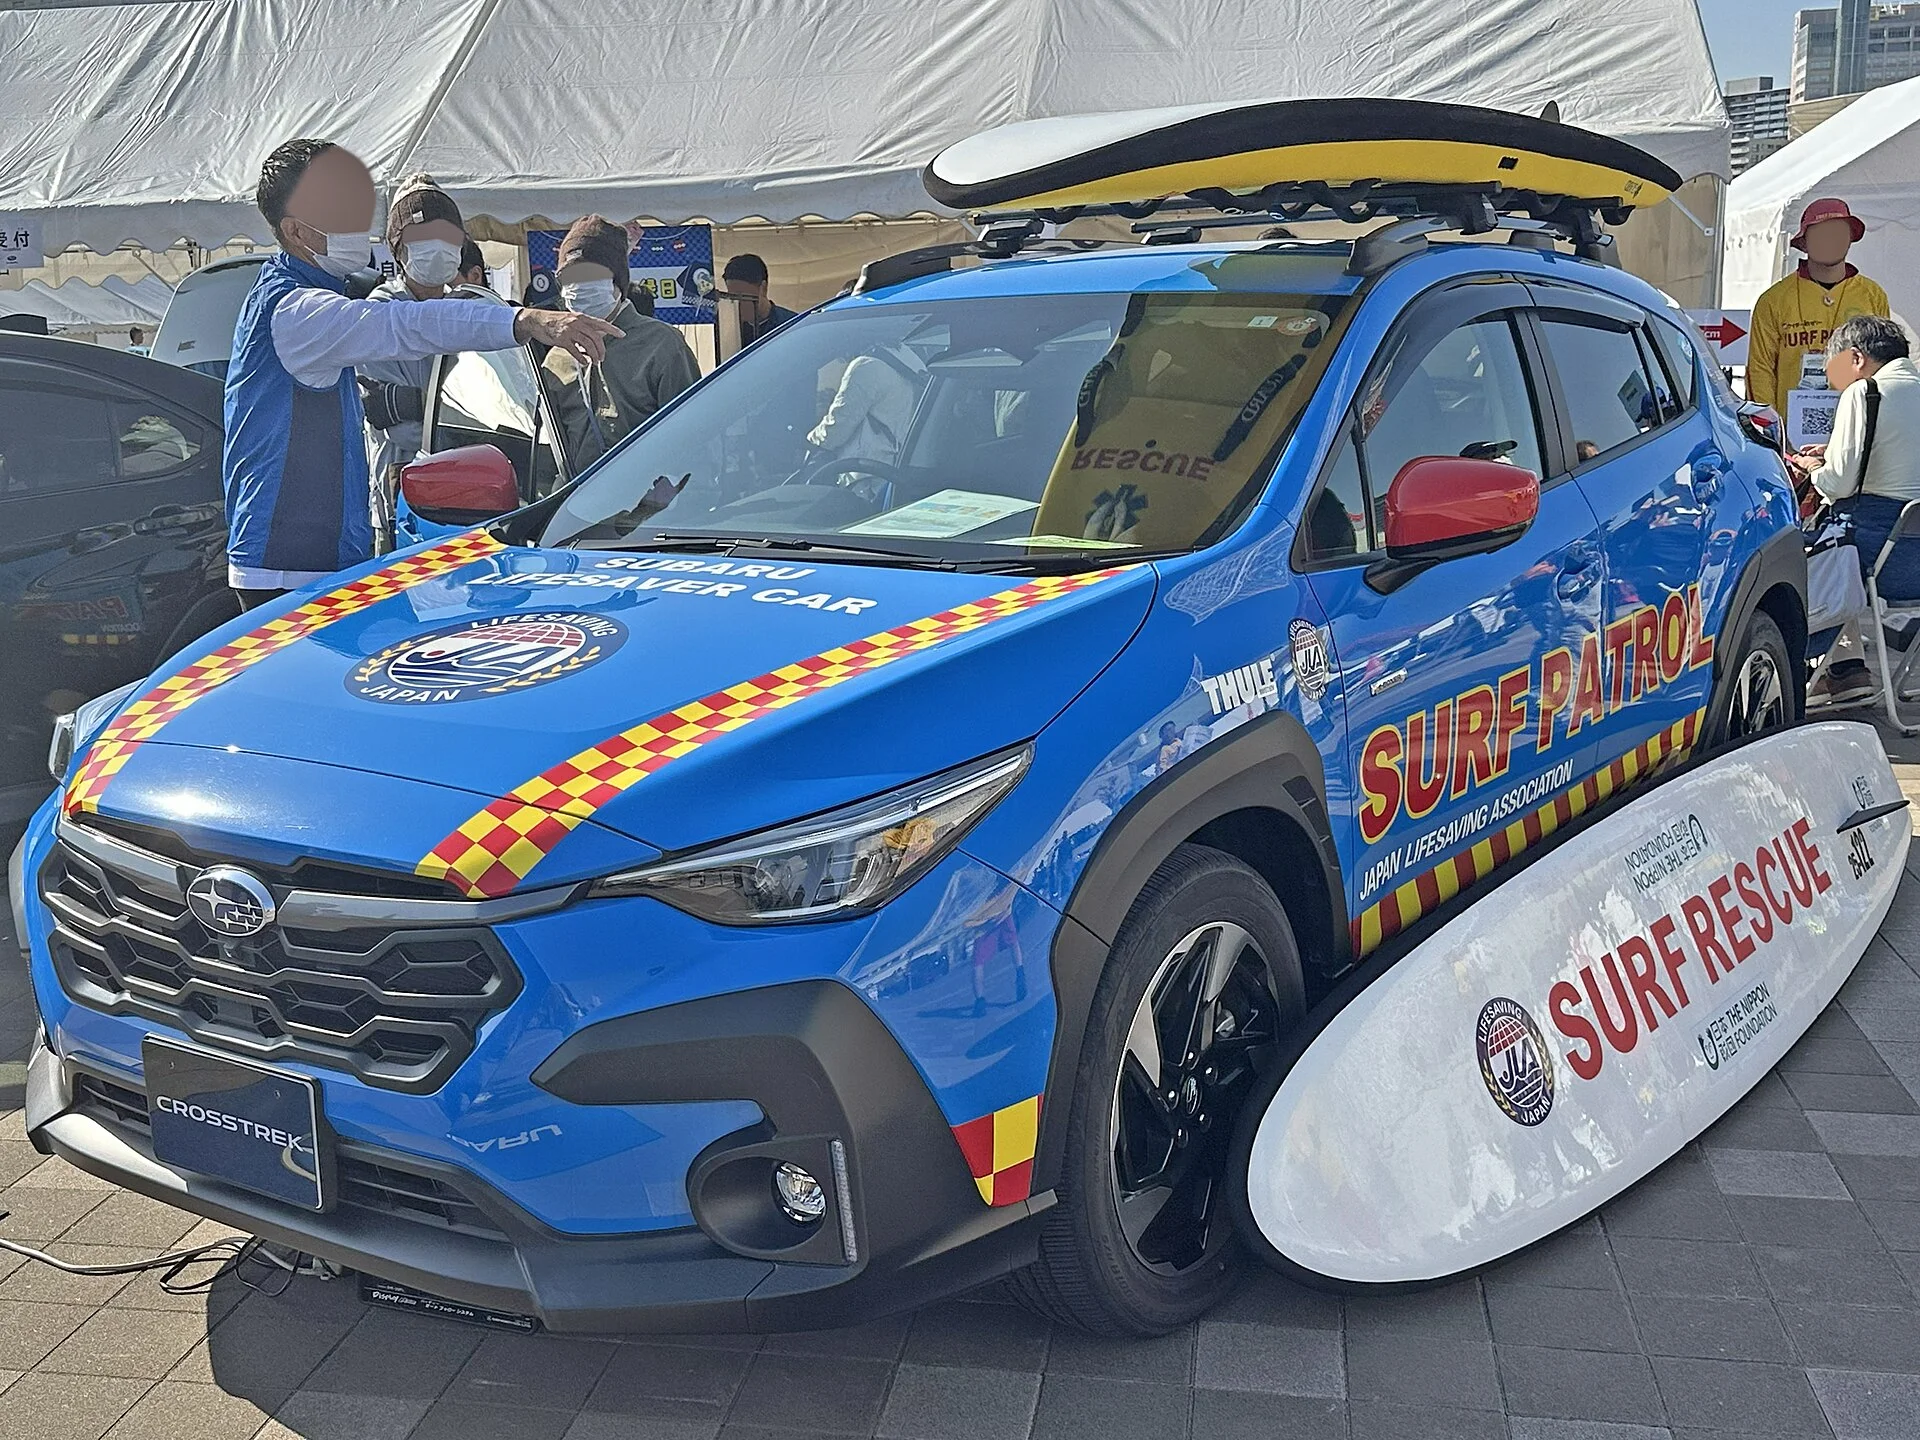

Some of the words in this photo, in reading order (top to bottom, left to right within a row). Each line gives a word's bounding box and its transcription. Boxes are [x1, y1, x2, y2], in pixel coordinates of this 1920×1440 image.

[595, 556, 816, 581] SUBARU
[466, 572, 748, 598] LIFESAVER
[752, 587, 878, 615] CAR
[471, 612, 620, 638] LIFESAVING
[360, 684, 461, 702] JAPAN
[1200, 658, 1279, 716] THULE
[1359, 664, 1531, 845] SURF
[1536, 581, 1716, 755] PATROL
[1359, 847, 1402, 901] JAPAN
[1404, 809, 1488, 869] LIFESAVING
[1489, 758, 1574, 825] ASSOCIATION
[1624, 829, 1675, 873] FOUNDATION
[1632, 858, 1669, 894] NIPPON
[1664, 849, 1683, 873] THE
[1548, 913, 1691, 1081] SURF
[1680, 816, 1833, 985] RESCUE
[1478, 1001, 1523, 1043] LIFESAVING
[1725, 1003, 1743, 1028] THE
[1740, 981, 1770, 1017] NIPPON
[1734, 1001, 1778, 1048] FOUNDATION
[156, 1095, 304, 1152] CROSSTREK
[1521, 1095, 1551, 1123] JAPAN
